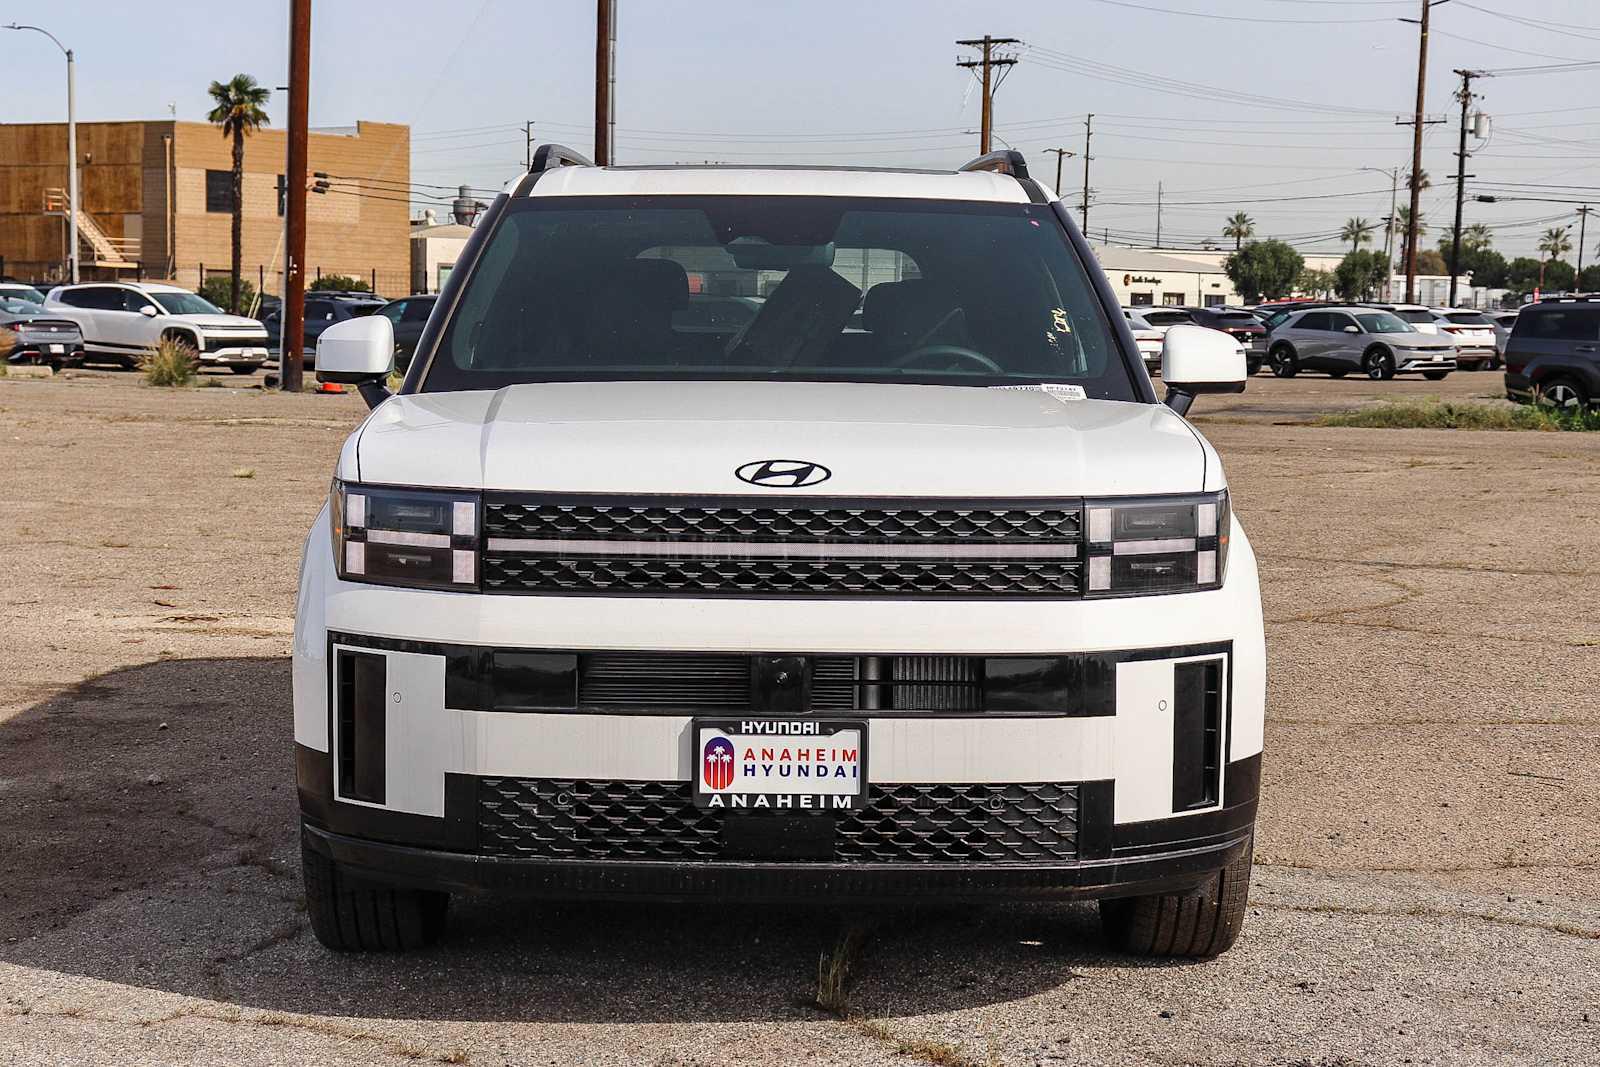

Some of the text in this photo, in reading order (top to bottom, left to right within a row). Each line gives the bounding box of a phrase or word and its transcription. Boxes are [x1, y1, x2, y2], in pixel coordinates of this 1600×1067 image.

[741, 721, 820, 735] HYUNDAI
[743, 748, 857, 762] ANAHEIM
[743, 764, 857, 778] HYUNDAI
[708, 794, 852, 809] ANAHEIM
